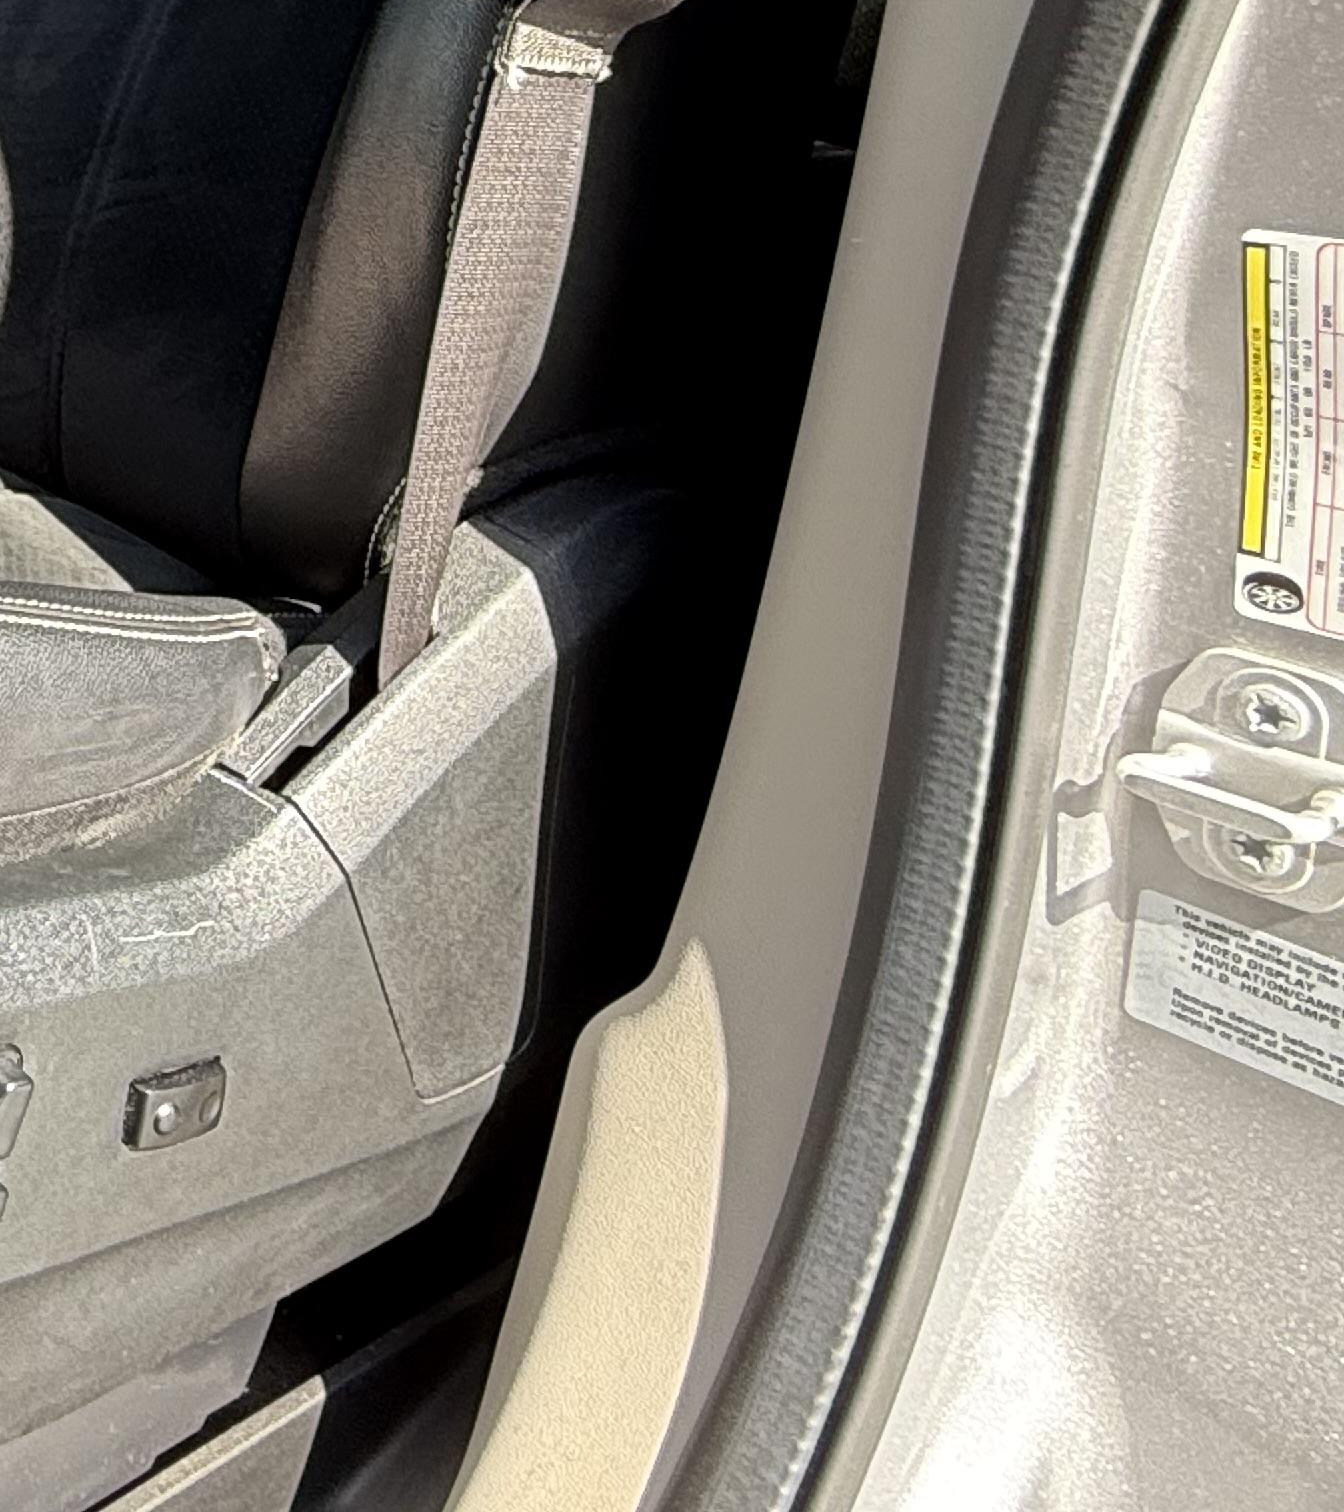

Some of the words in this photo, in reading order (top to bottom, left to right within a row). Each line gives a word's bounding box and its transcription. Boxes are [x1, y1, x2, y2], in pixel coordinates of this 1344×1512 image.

[1174, 905, 1201, 922] This
[1255, 939, 1284, 955] may
[1193, 949, 1344, 1018] NAVIGATION/CAME
[1195, 937, 1243, 964] VIDEO
[1247, 958, 1316, 992] DISPLAY
[1240, 981, 1340, 1029] HEADLAMPS
